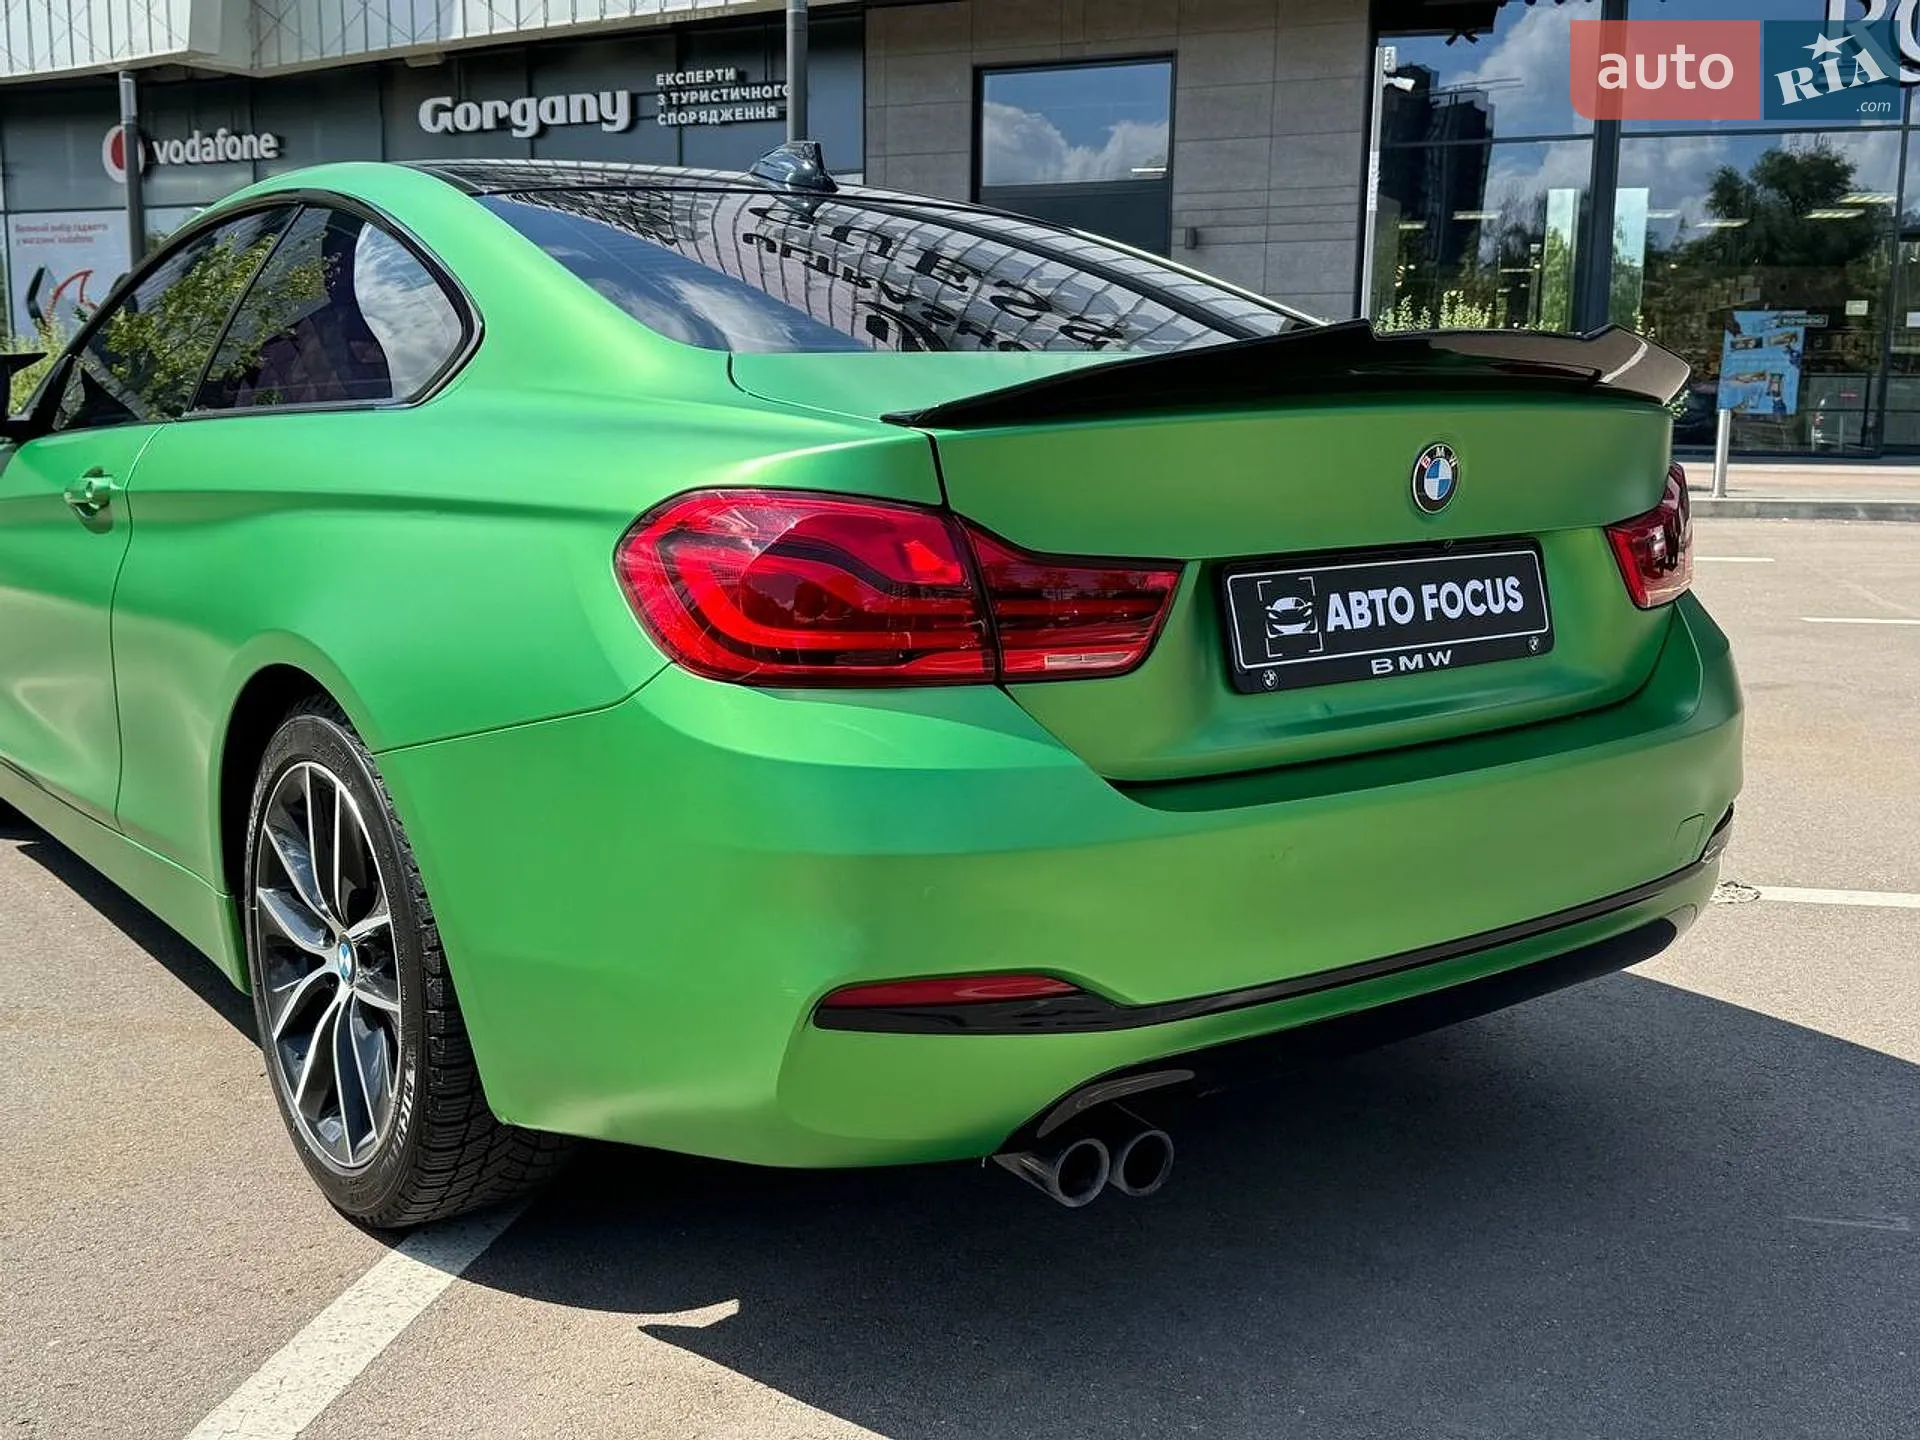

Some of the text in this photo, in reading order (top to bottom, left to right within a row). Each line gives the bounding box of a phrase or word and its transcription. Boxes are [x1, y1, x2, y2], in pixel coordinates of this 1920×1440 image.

[655, 67, 736, 86] ЕКСПЕРТИ
[418, 89, 631, 138] Gorgany
[657, 106, 777, 125] СПОРЯДЖЕННЯ
[152, 127, 279, 164] vodafone
[1327, 576, 1524, 632] АВТО FOCUS
[1371, 650, 1453, 675] BMW
